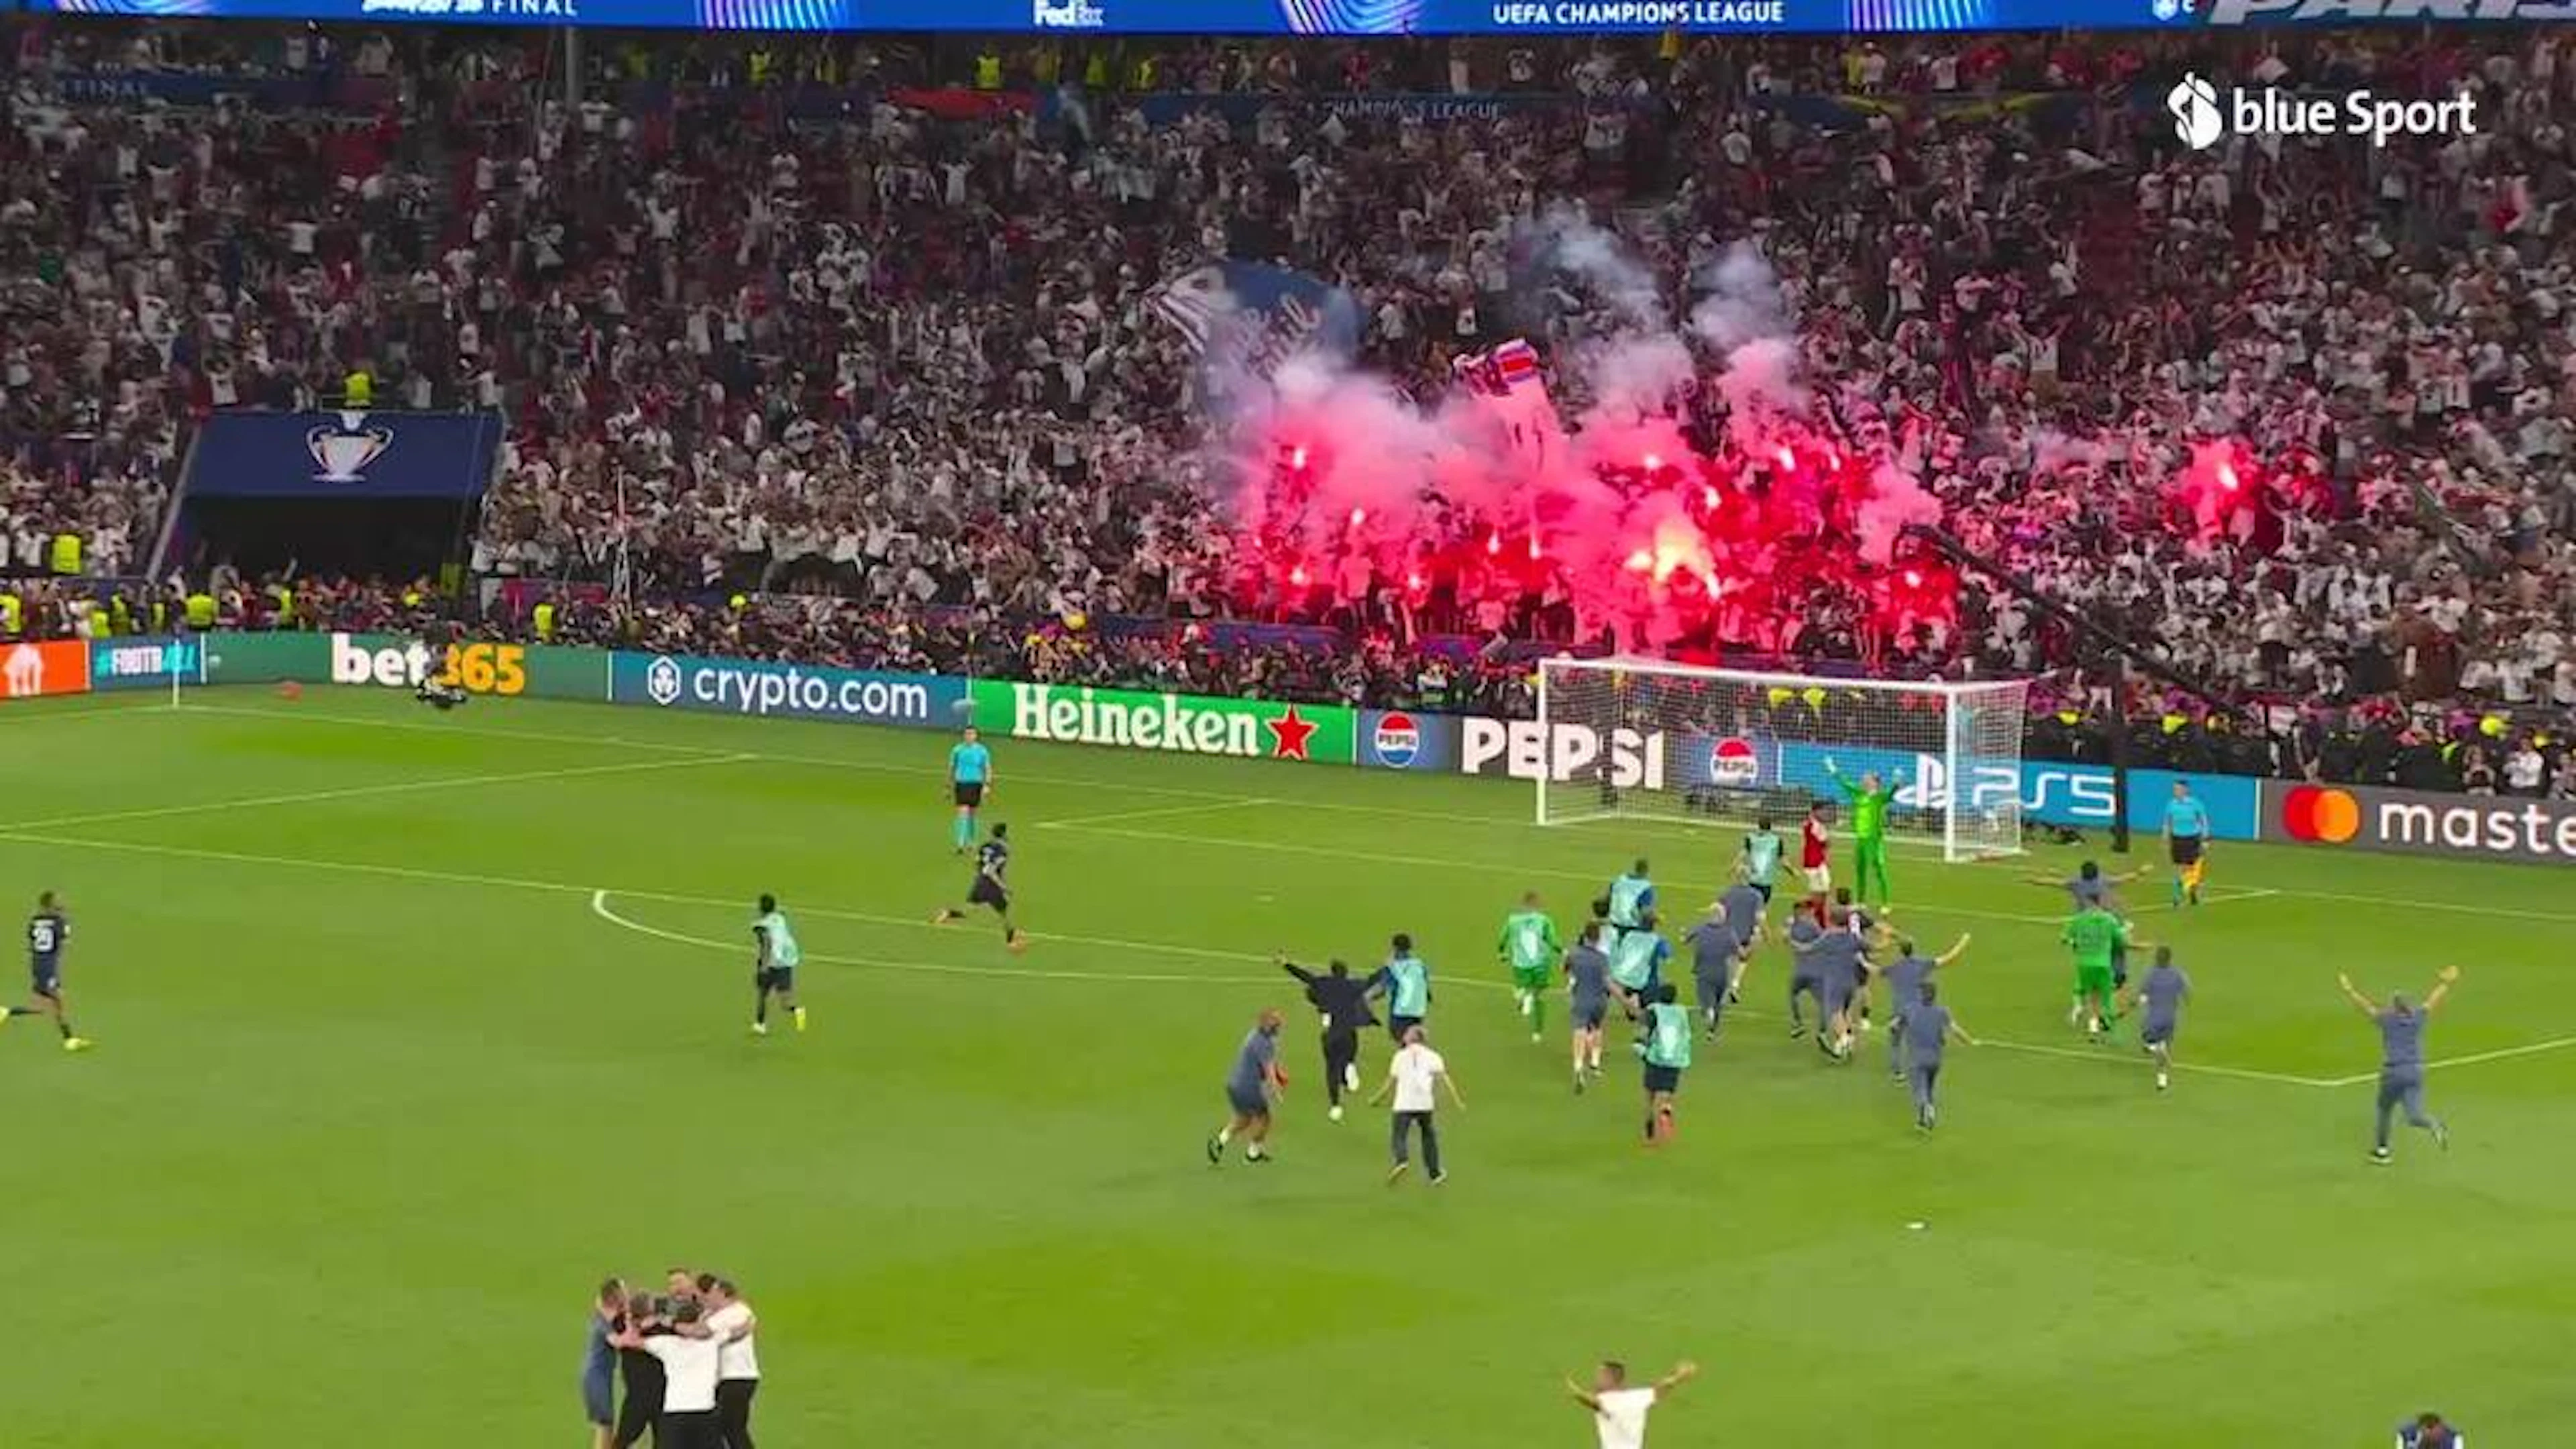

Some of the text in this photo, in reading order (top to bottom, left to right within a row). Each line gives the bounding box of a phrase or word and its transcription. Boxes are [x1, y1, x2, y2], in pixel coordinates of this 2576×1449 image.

[1034, 0, 1104, 26] FedEx
[1493, 1, 1784, 24] UEFA CHAMPIONS LEAGUE
[331, 632, 526, 695] bet365
[694, 667, 927, 718] crypto.com
[1012, 683, 1263, 757] Heineken
[1462, 716, 1664, 790] PEPSI
[1972, 765, 2115, 816] PS5
[2380, 803, 2576, 859] maste
